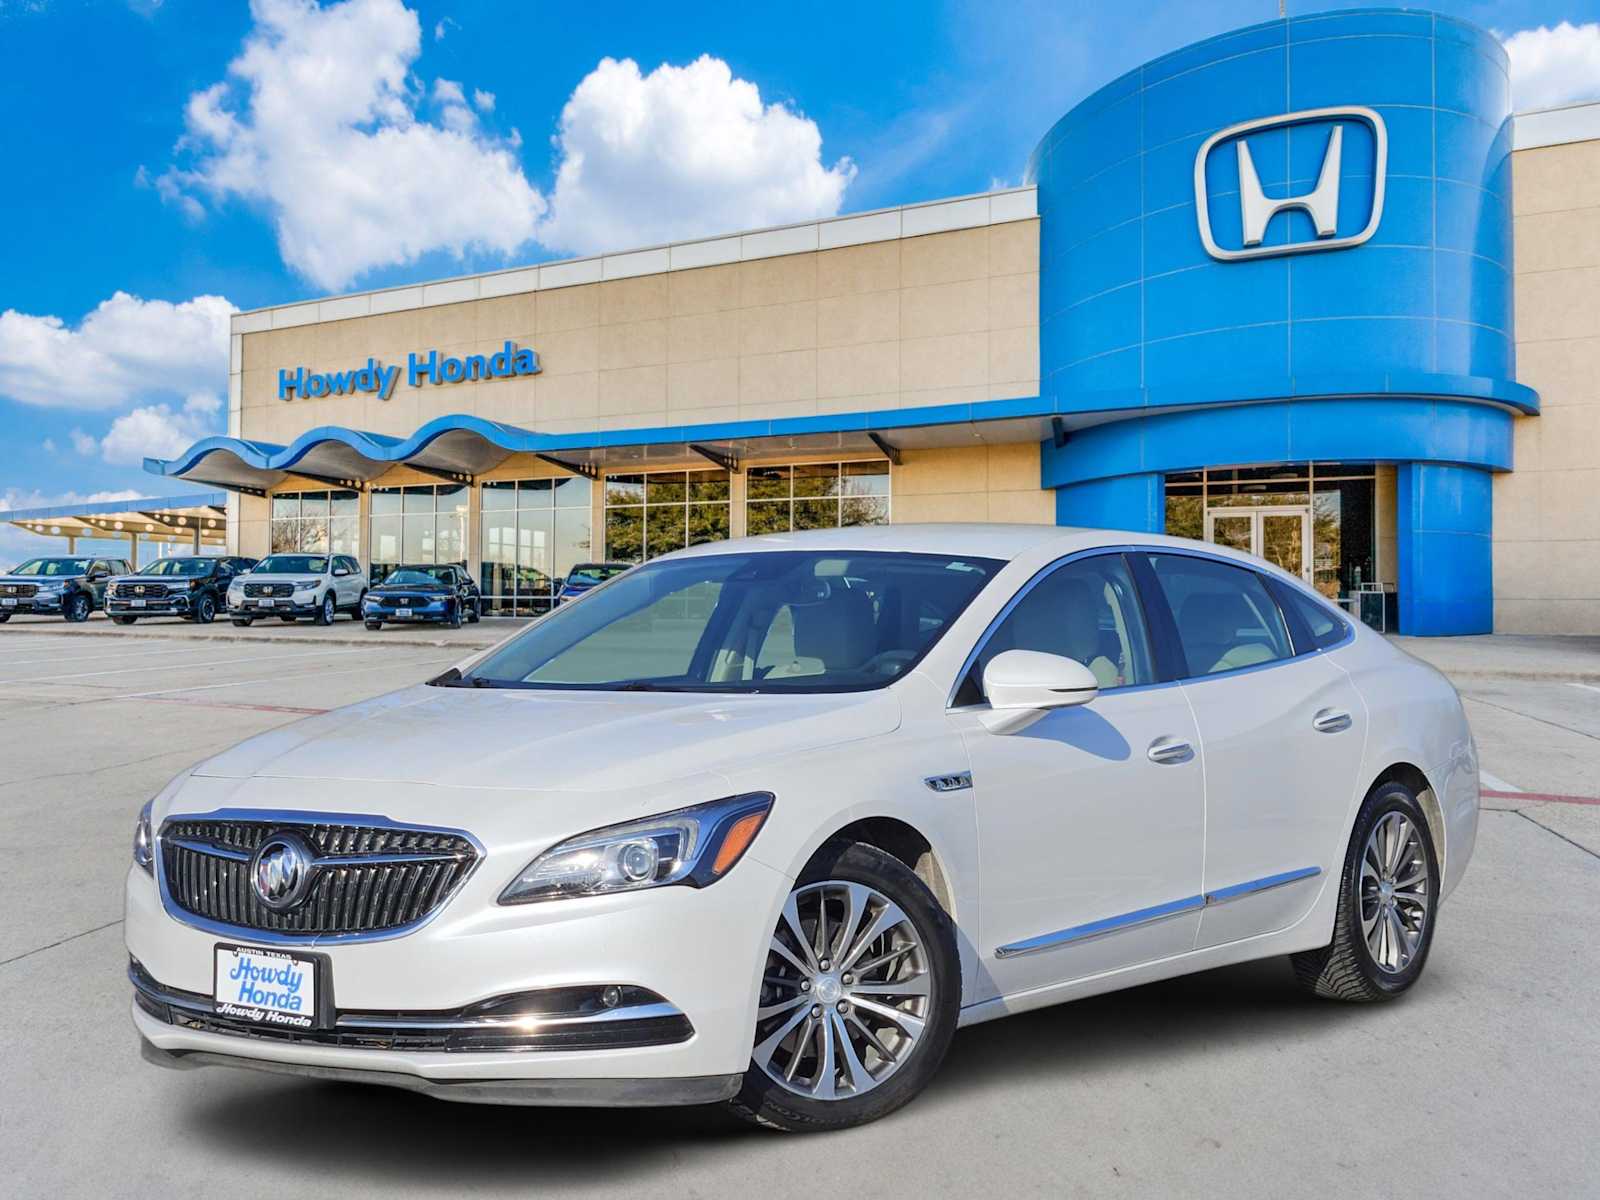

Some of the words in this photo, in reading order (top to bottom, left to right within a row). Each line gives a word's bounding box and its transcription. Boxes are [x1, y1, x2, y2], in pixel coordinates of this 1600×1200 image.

[278, 358, 401, 401] Howdy
[408, 341, 542, 388] Honda
[230, 957, 303, 993] Howdy
[239, 981, 302, 1011] Honda
[216, 1003, 265, 1021] Howdy
[266, 1011, 312, 1027] Honda
